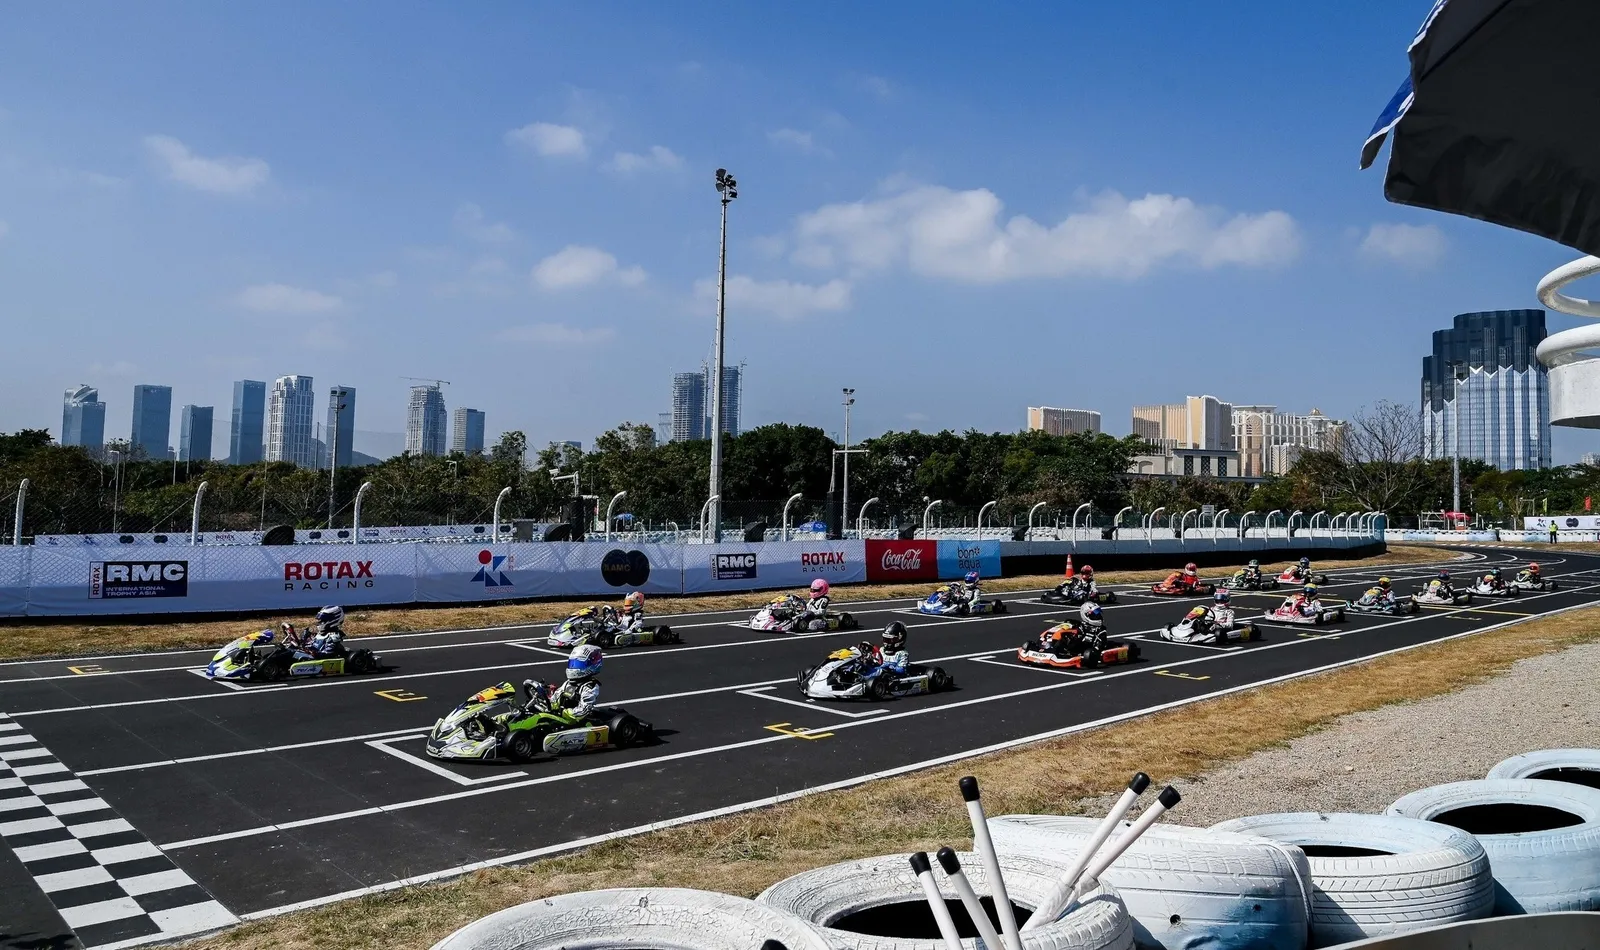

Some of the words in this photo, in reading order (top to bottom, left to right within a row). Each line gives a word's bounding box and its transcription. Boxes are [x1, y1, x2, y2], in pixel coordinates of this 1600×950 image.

[801, 551, 845, 566] ROTAX
[881, 547, 923, 571] Coca-Cola
[957, 545, 975, 559] bon
[717, 555, 755, 569] RMC
[958, 559, 981, 571] aqua
[106, 563, 185, 582] RMC
[284, 560, 374, 581] ROTAX
[92, 566, 100, 596] ROTAX
[284, 580, 374, 591] RACING
[329, 662, 335, 670] 7
